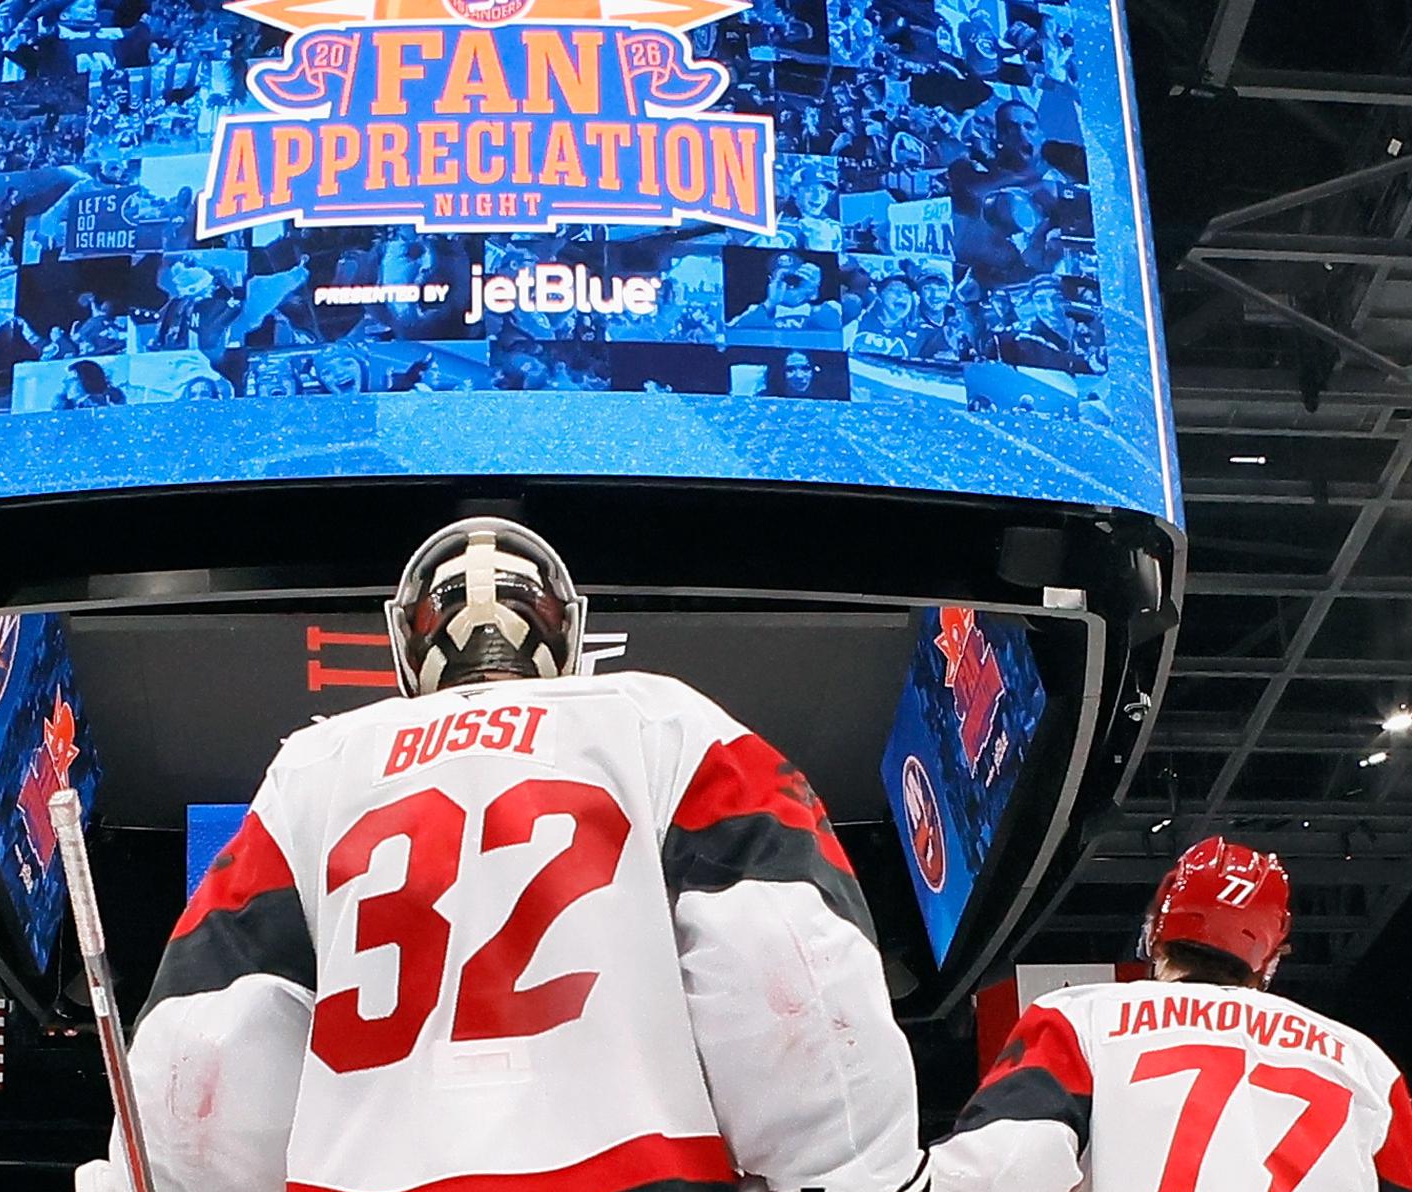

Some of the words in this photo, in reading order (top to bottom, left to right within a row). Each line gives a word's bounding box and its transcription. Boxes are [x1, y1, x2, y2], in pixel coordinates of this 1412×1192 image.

[313, 43, 344, 67] 20
[372, 31, 605, 115] FAN
[631, 43, 661, 66] 26
[214, 120, 759, 218] APPRECIATION
[434, 194, 542, 217] NIGHT
[314, 285, 419, 306] PRESENTED
[423, 285, 449, 303] BY
[465, 264, 656, 325] jetBlue
[384, 705, 548, 778] BUSSI
[1216, 875, 1254, 905] 77
[309, 778, 632, 1074] 32
[1108, 995, 1346, 1064] JANKOWSKI
